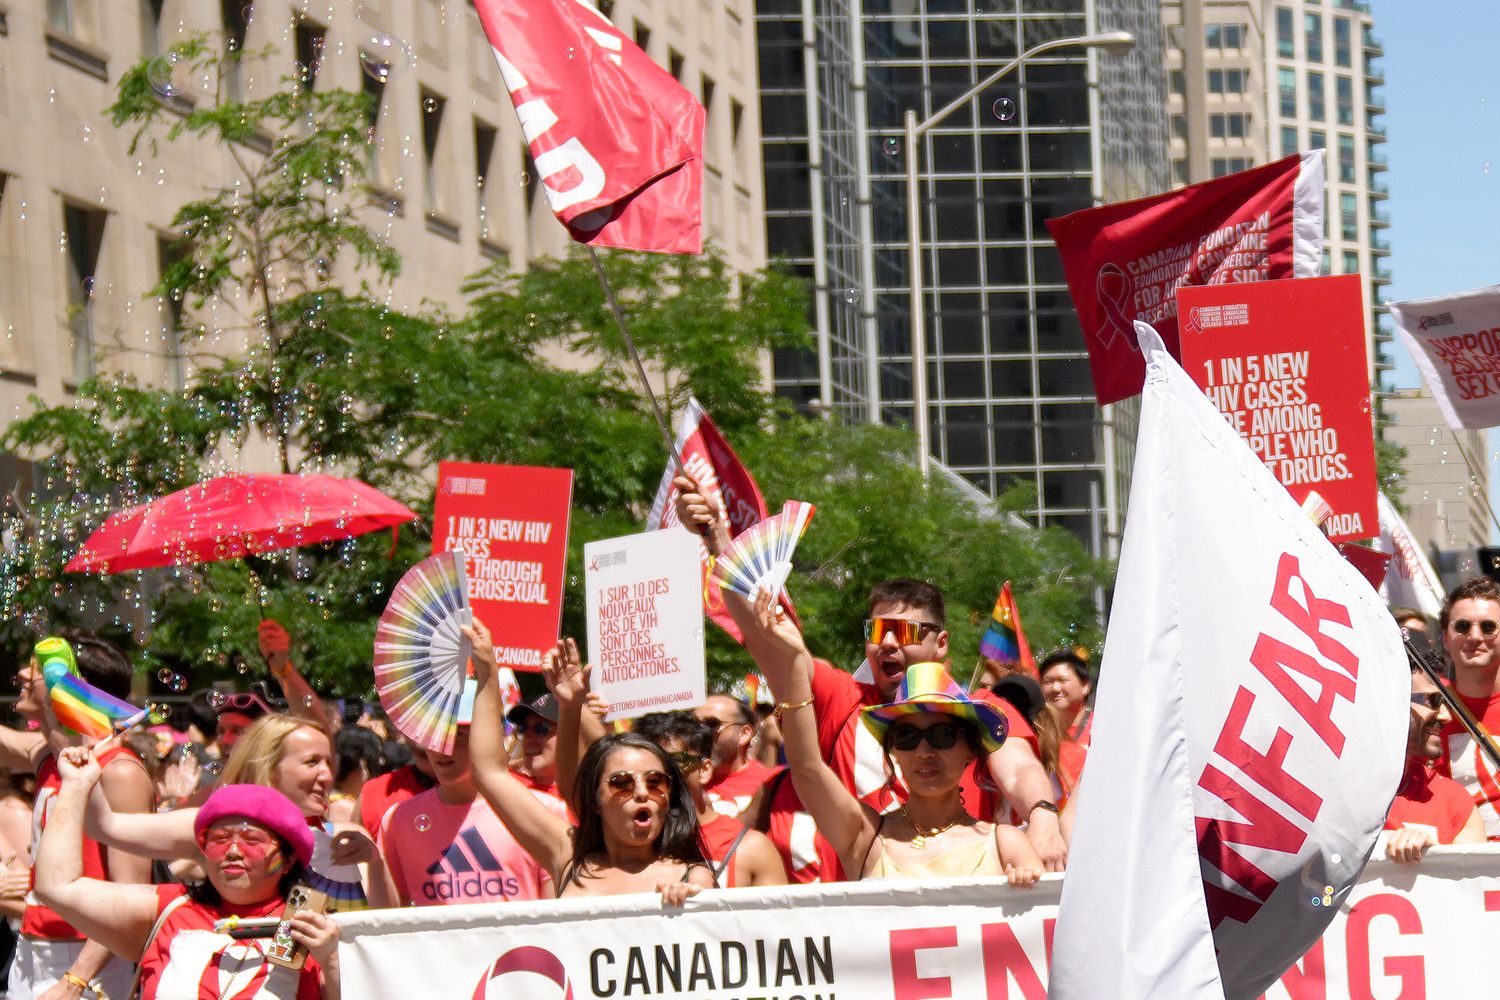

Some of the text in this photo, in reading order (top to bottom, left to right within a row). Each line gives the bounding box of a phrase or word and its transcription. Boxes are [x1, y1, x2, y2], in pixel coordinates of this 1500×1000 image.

[1204, 351, 1310, 386] 1 IN 5 NEW
[1205, 377, 1307, 412] HIV CASES
[1454, 374, 1498, 401] SEX
[1252, 403, 1322, 436] AMONG
[1290, 427, 1338, 459] WHO
[1282, 453, 1353, 486] DRUGS.
[447, 515, 553, 545] 1 IN 3 NEW HIV
[445, 536, 493, 560] CASES
[474, 558, 544, 582] THROUGH
[598, 577, 669, 603] 1 SUR 10 DES
[599, 596, 656, 621] NOUVEAUX
[599, 611, 658, 637] CAS DE VIH
[600, 630, 651, 652] SONT DES
[600, 643, 665, 669] PERSONNES
[601, 657, 681, 685] AUTOCHTONES.
[422, 872, 519, 900] adidas
[589, 936, 835, 998] CANADIAN
